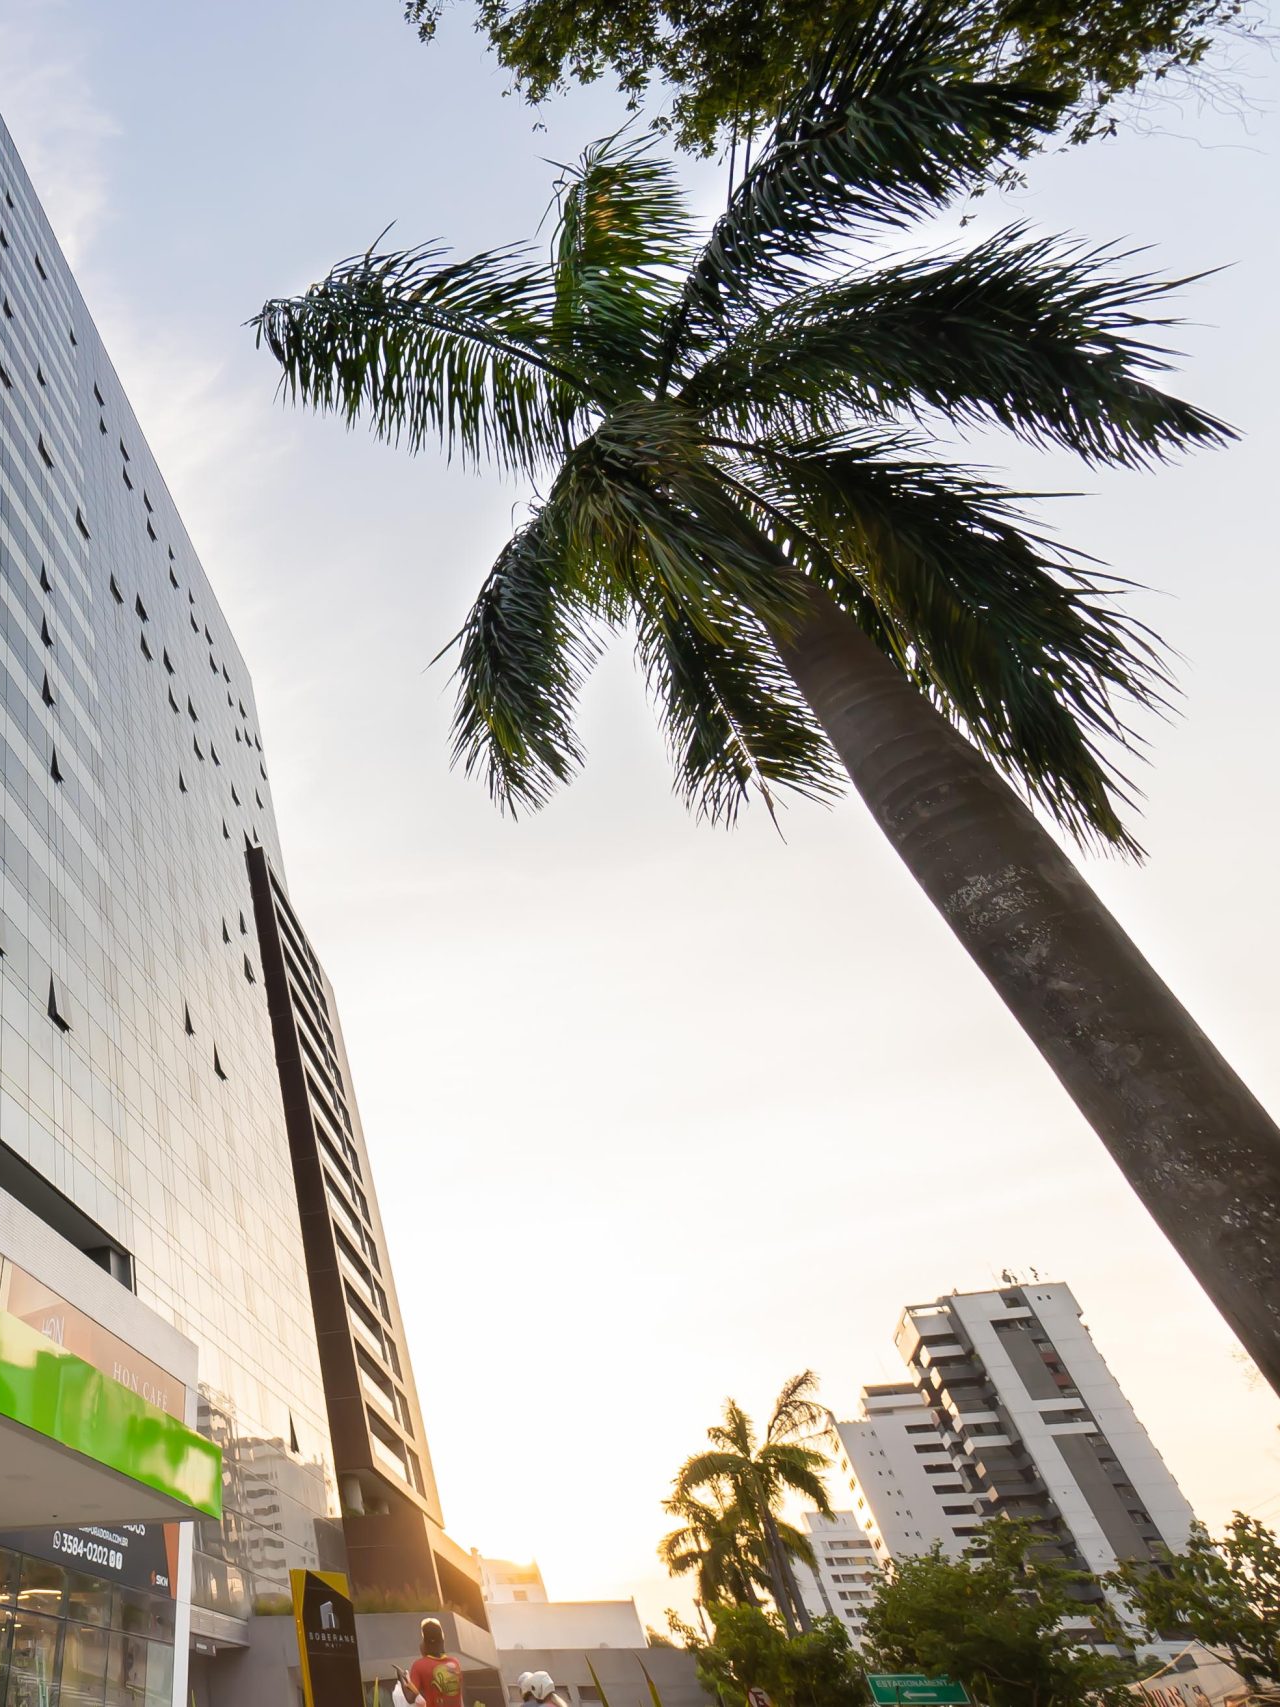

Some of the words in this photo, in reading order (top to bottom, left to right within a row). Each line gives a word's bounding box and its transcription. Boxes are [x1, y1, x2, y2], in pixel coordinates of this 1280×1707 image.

[113, 1361, 139, 1392] HON
[61, 1533, 108, 1566] 3584-0202
[156, 1575, 169, 1587] SKN
